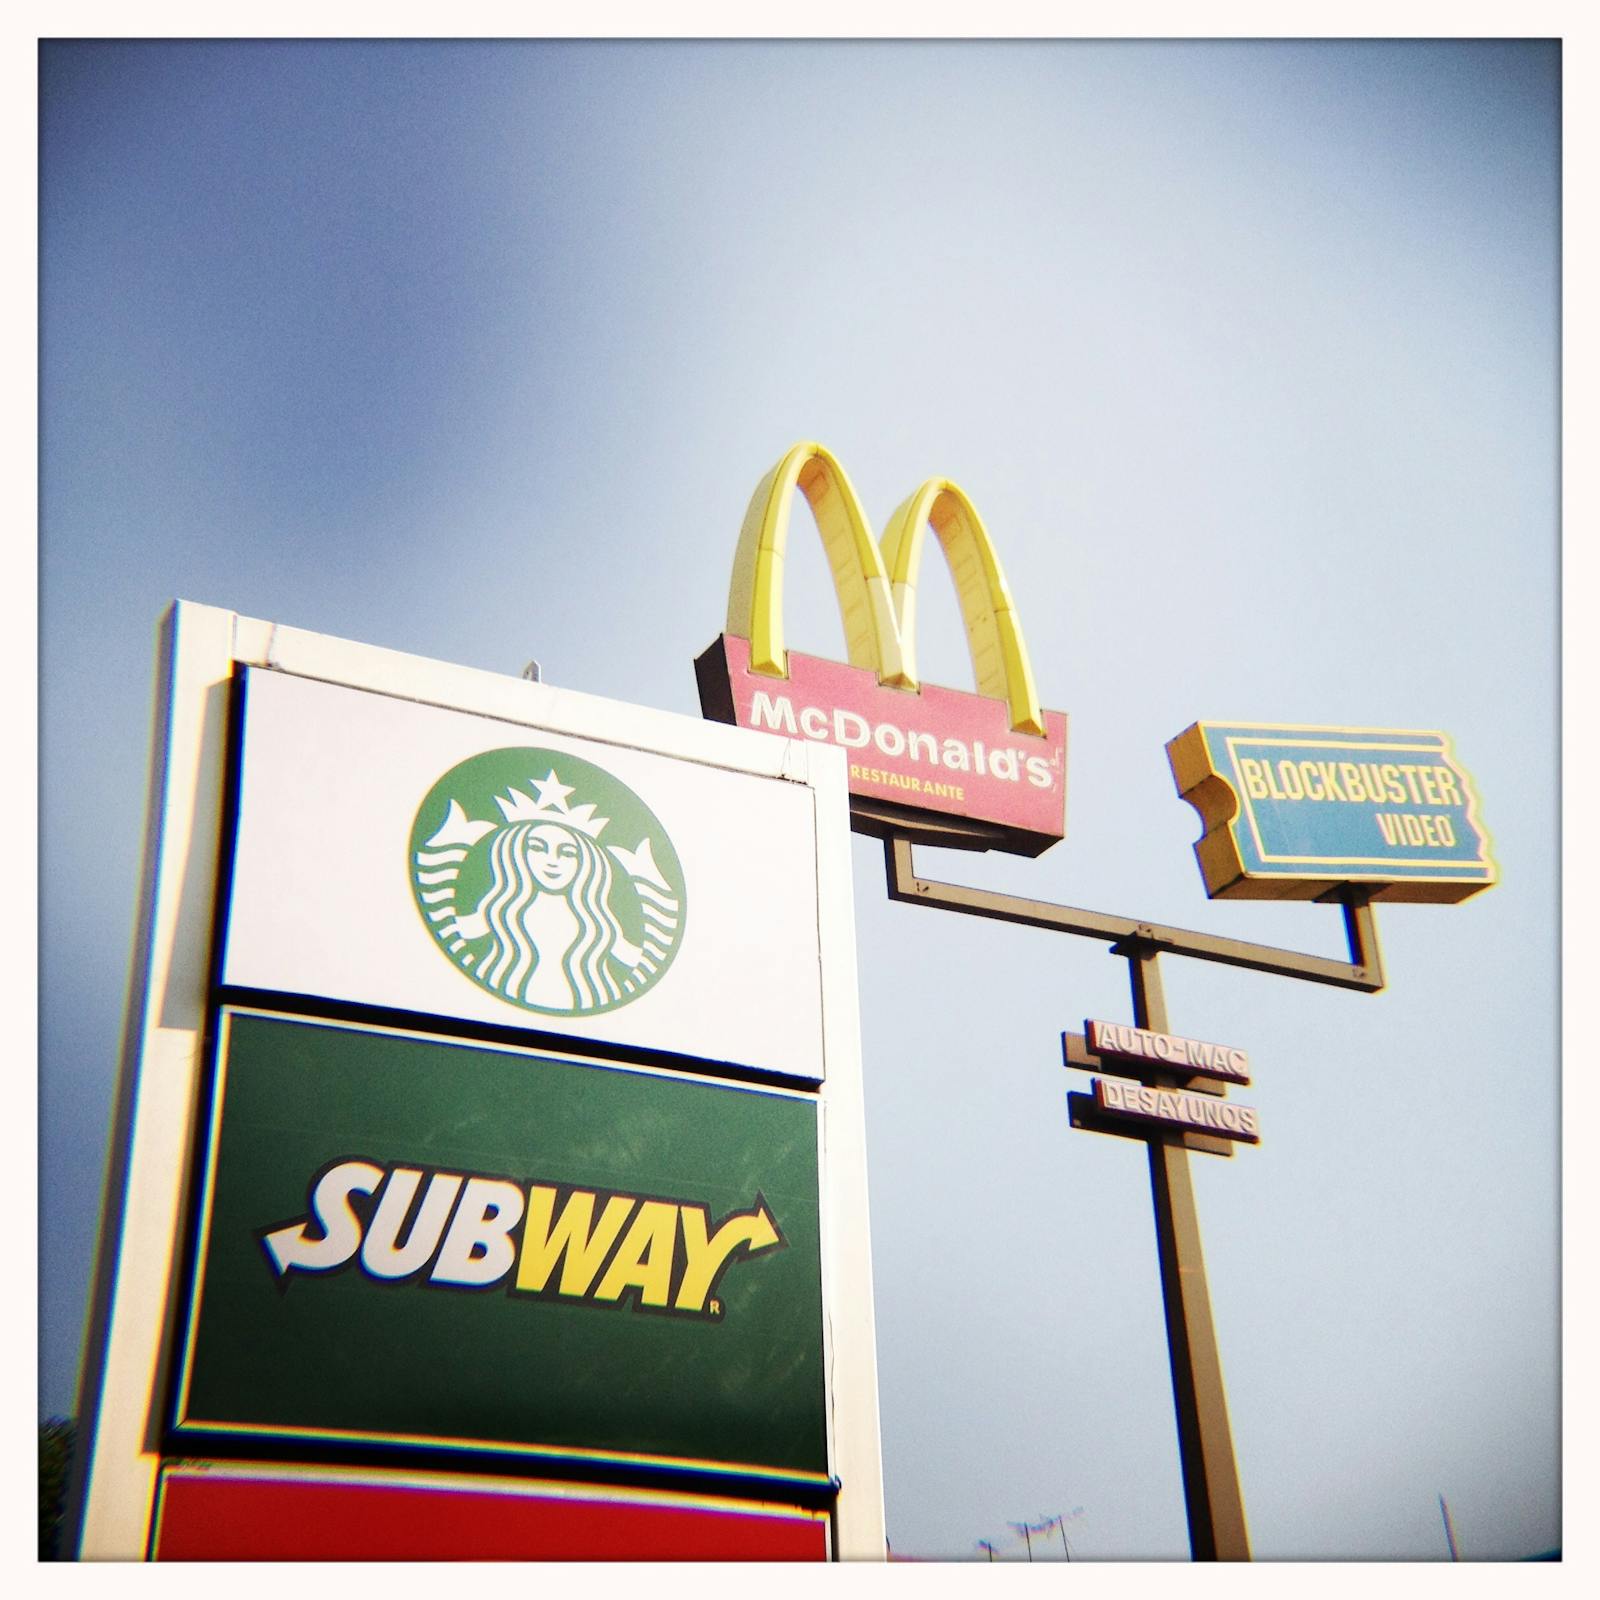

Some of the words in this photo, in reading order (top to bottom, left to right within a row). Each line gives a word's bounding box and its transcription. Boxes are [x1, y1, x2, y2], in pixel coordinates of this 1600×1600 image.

[750, 690, 1054, 789] McDonald's
[850, 764, 965, 802] RESTAURANTE
[1241, 757, 1463, 807] BLOCKBUSTER
[1375, 812, 1456, 848] VIDEO
[1098, 1023, 1247, 1076] AUTO-MAC
[1104, 1081, 1255, 1134] DESAYUNOS
[264, 1161, 780, 1312] SUBWAY
